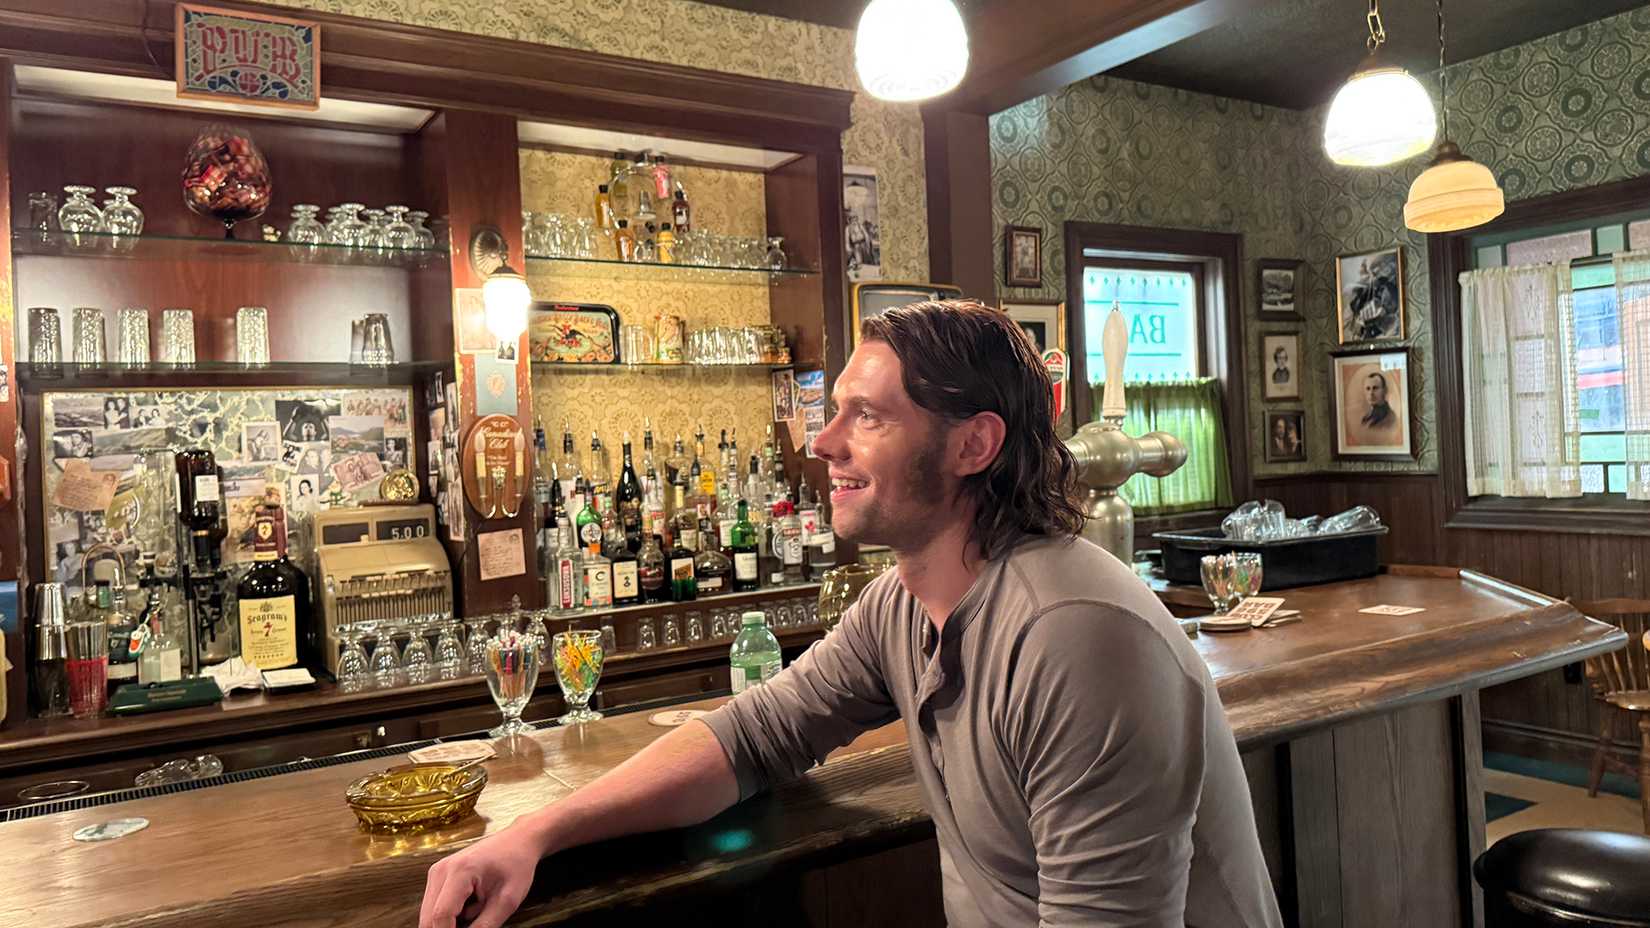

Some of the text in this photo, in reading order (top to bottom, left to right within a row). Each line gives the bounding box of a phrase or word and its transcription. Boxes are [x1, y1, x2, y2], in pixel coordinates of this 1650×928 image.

[194, 22, 301, 82] PUB
[247, 613, 288, 625] Seagram's
[263, 622, 273, 637] 7
